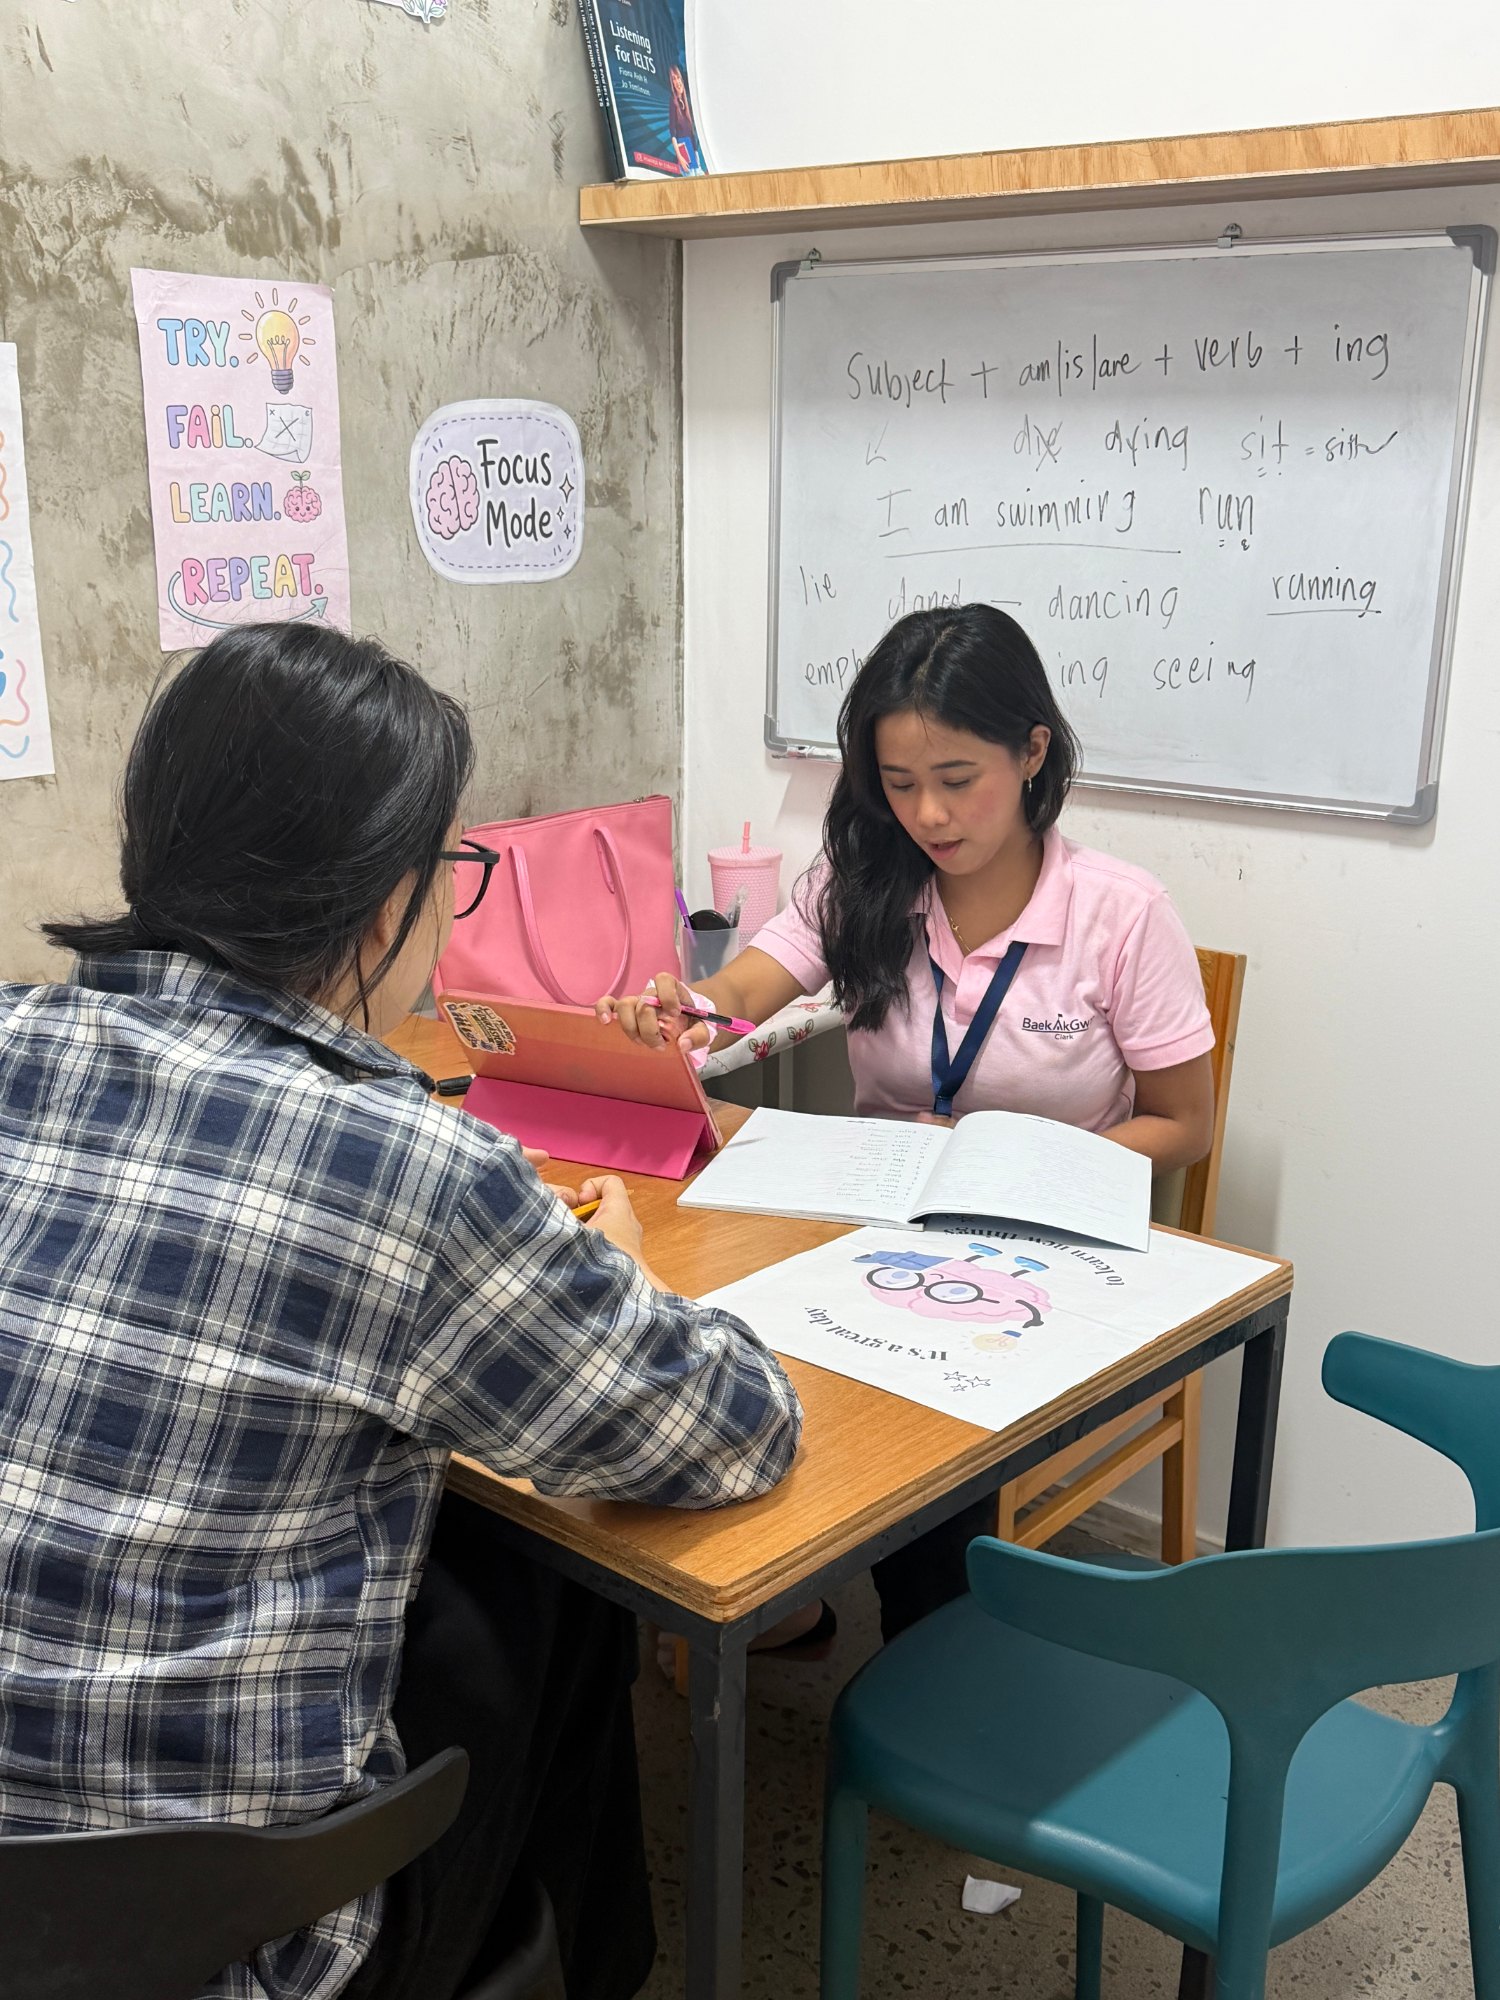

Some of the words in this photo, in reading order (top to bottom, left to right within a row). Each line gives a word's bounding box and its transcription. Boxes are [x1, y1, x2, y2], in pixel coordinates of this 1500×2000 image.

[584, 28, 596, 68] LISTENING
[592, 69, 600, 85] FOR
[610, 20, 652, 54] Listening
[615, 45, 631, 63] for
[632, 50, 656, 74] IELTS
[157, 318, 239, 368] TRY.
[847, 352, 954, 408] Subject
[1195, 331, 1263, 372] verb
[1334, 324, 1389, 381] ing
[477, 438, 552, 488] Focus
[1105, 417, 1188, 471] dying
[1241, 415, 1289, 464] sit
[170, 482, 282, 523] LEARN.
[485, 498, 553, 548] Mode
[877, 489, 912, 537] I
[934, 497, 970, 528] am
[1200, 486, 1254, 535] run
[180, 553, 324, 605] REPEAT.
[800, 565, 836, 605] lie
[1048, 580, 1179, 629] dancing
[1272, 566, 1377, 618] running
[1154, 641, 1256, 703] seeing
[1054, 1033, 1074, 1041] Clark
[943, 1226, 1018, 1241] things
[1024, 1235, 1069, 1252] new
[1071, 1249, 1115, 1275] learn
[1107, 1274, 1125, 1287] to
[804, 1306, 833, 1325] day
[826, 1325, 888, 1350] great
[887, 1344, 903, 1353] a
[907, 1348, 948, 1362] It's
